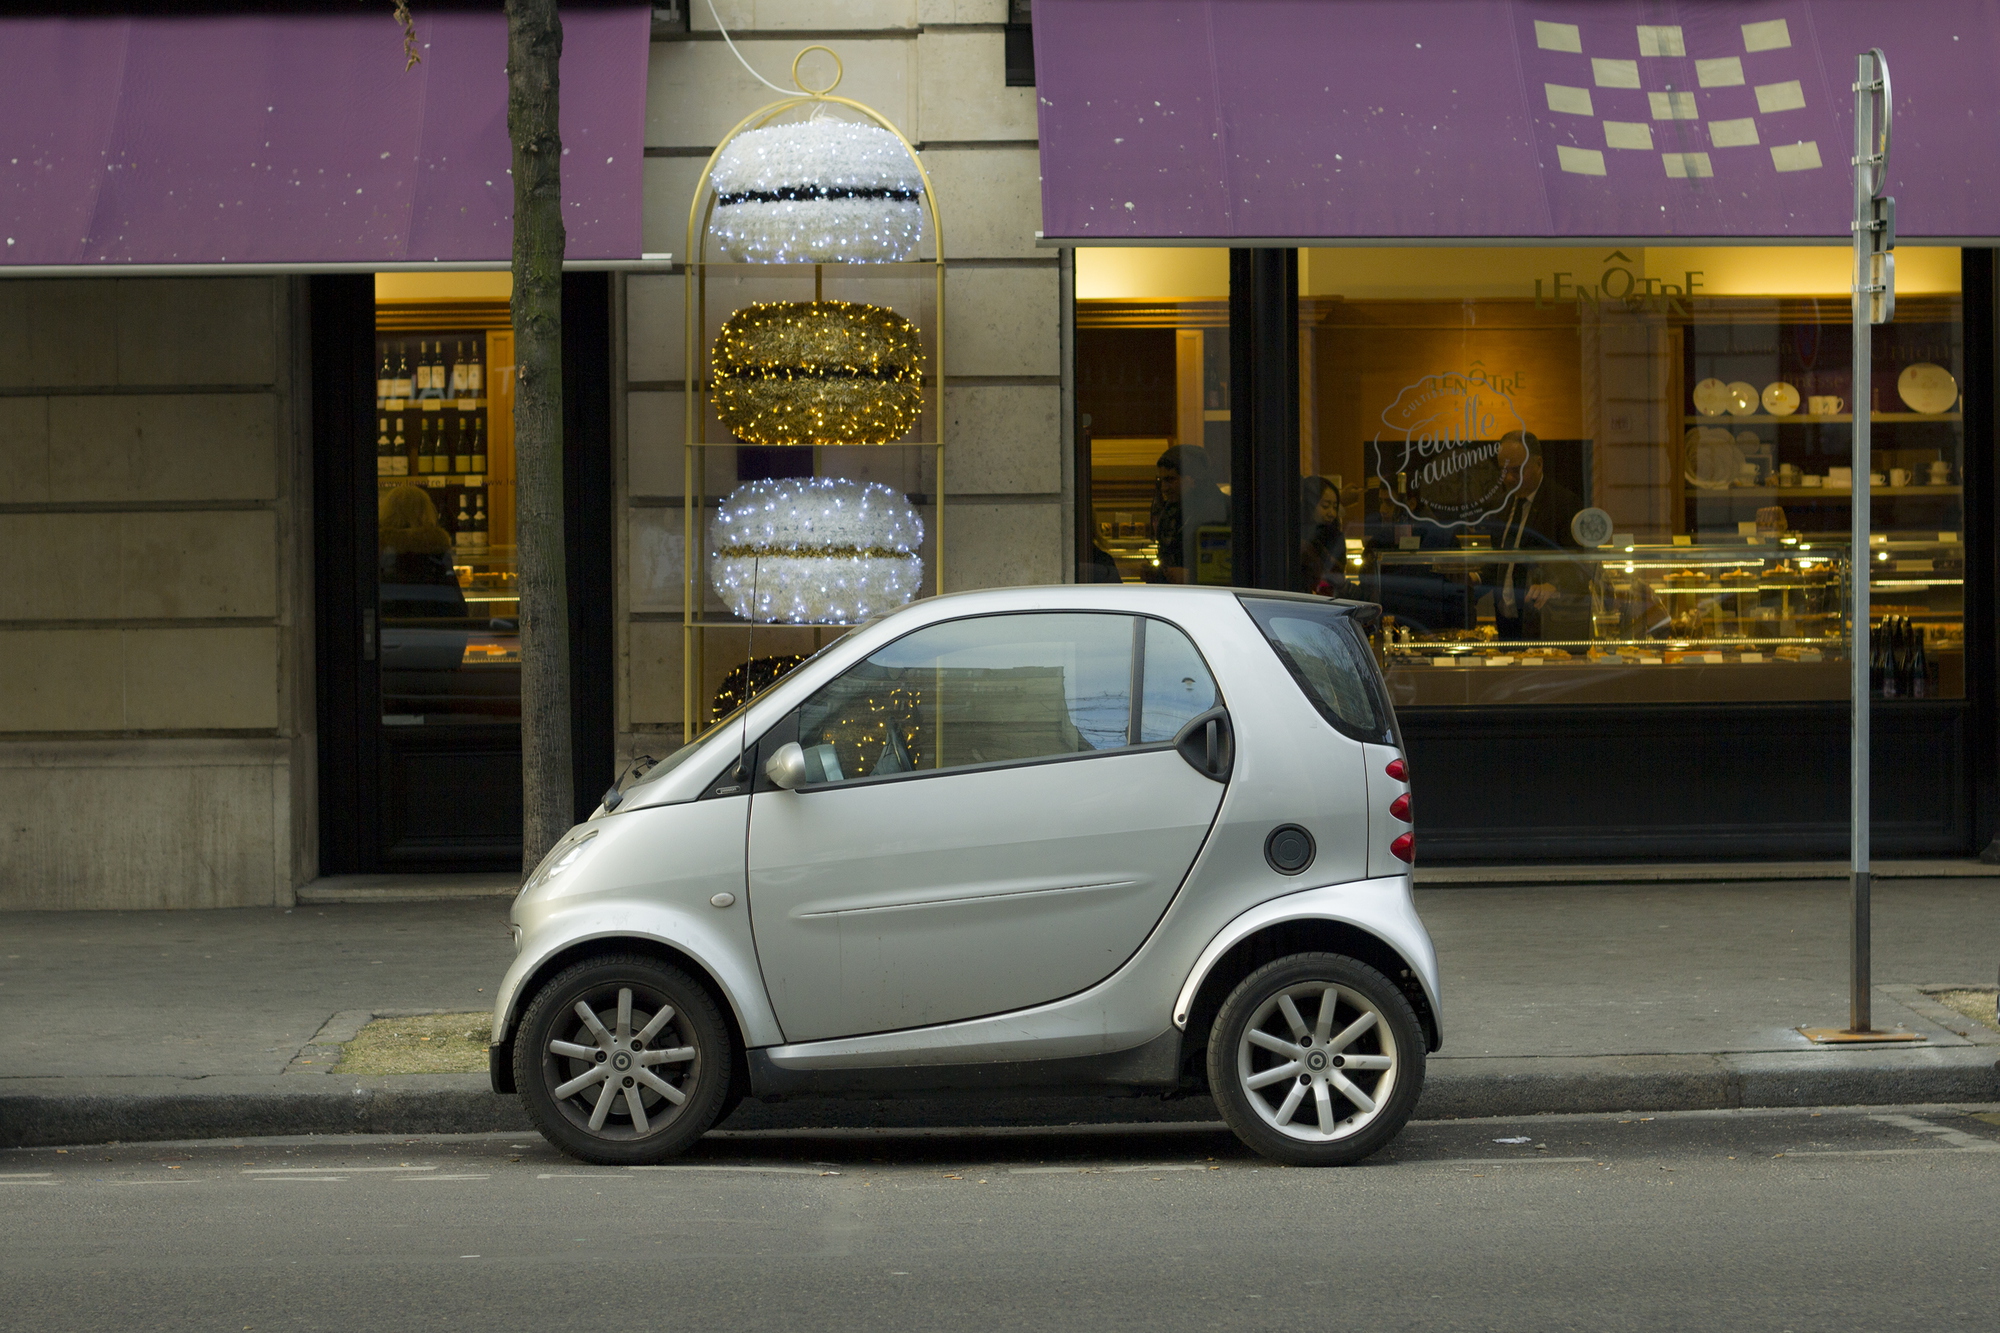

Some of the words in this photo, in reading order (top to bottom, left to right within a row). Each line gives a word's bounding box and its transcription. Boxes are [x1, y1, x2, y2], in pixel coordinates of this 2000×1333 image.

[1534, 250, 1704, 317] LENÔTRE
[1395, 394, 1499, 475] Feuille
[1410, 441, 1503, 490] d'automne
